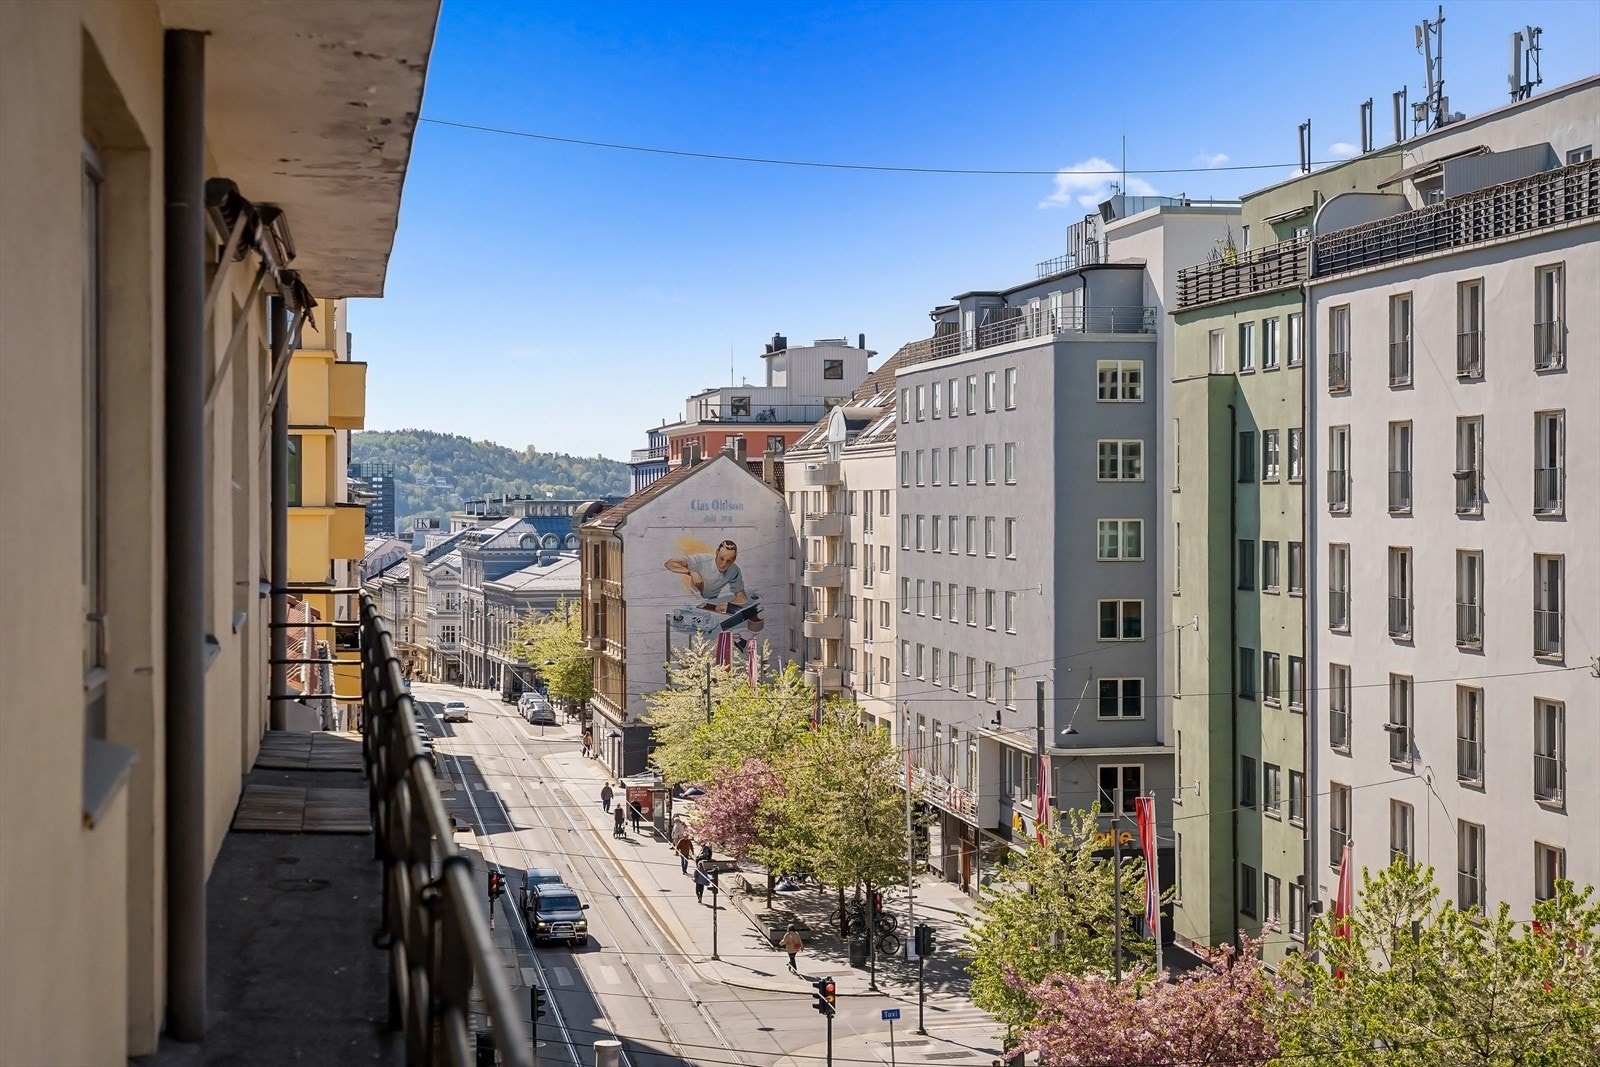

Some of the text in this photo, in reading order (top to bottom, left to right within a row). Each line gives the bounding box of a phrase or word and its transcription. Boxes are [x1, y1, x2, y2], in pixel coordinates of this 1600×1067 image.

[690, 499, 744, 511] Clas Ohlson
[884, 1010, 898, 1018] Taxi
